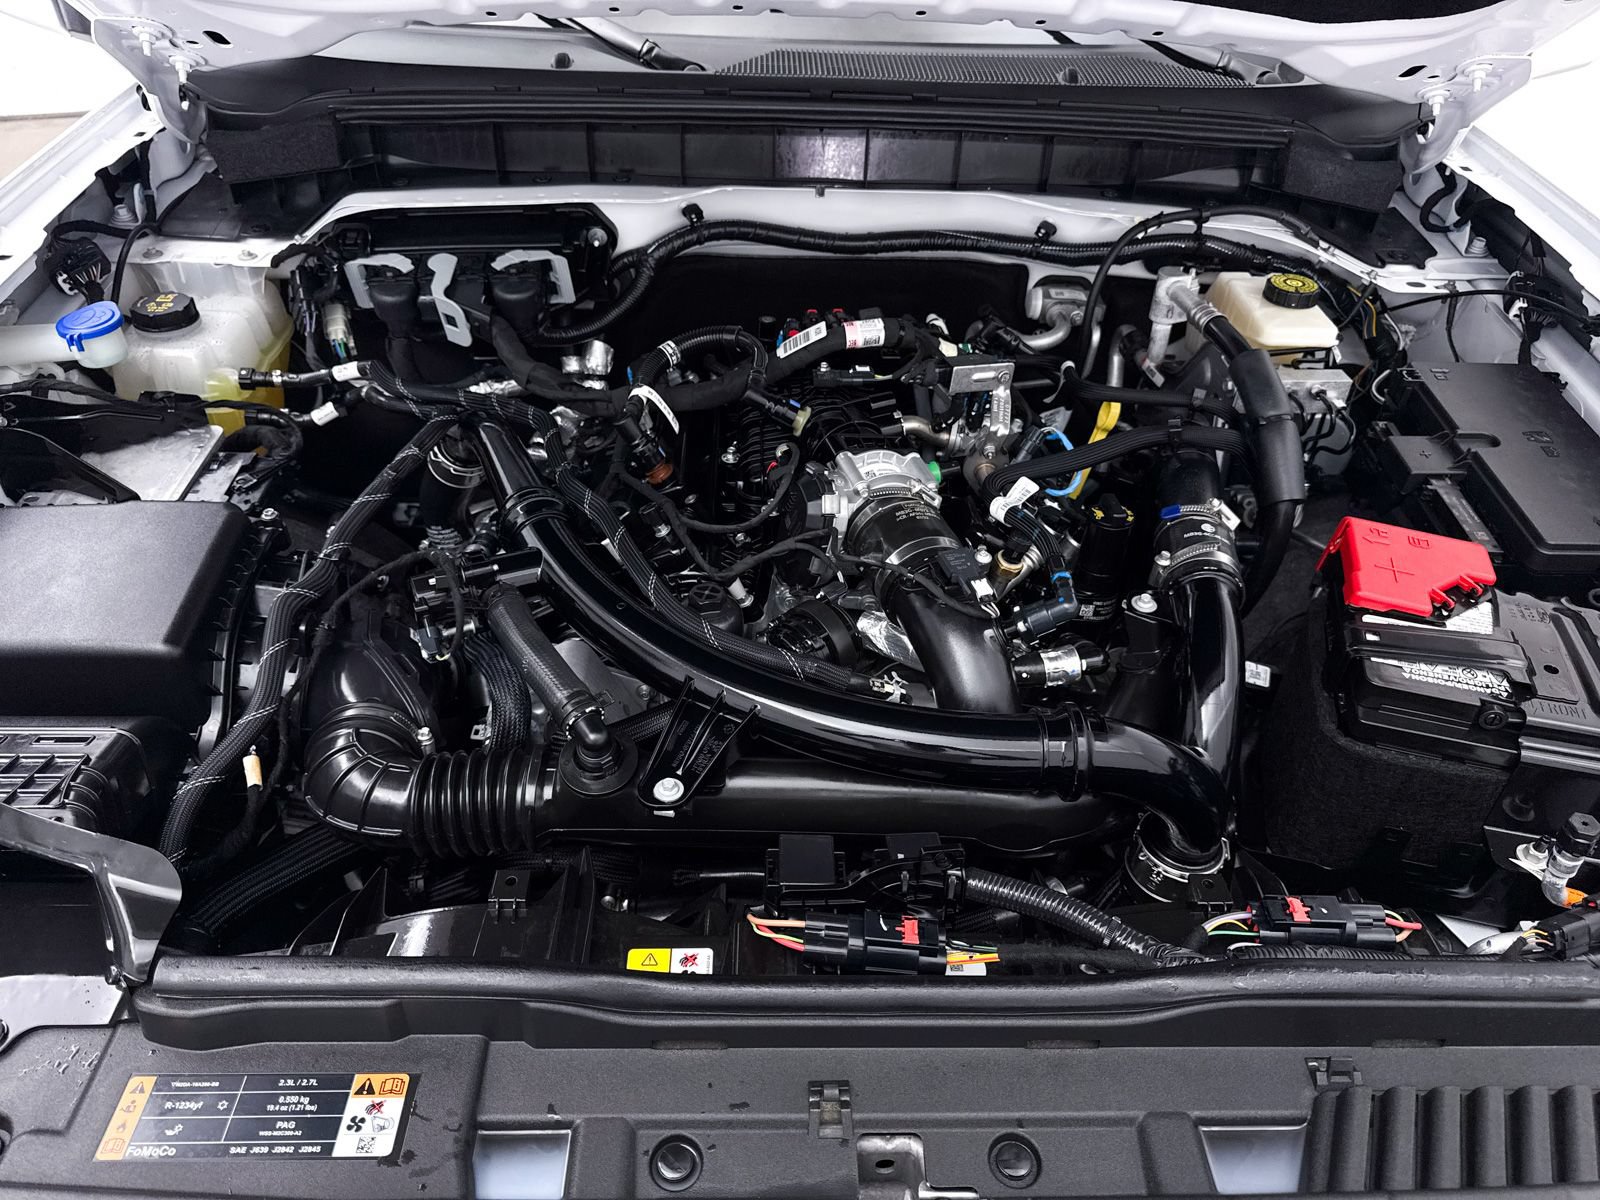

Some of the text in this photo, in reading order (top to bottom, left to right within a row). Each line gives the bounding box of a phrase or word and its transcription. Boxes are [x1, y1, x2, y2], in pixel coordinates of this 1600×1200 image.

[301, 1078, 318, 1086] 2.7L
[299, 1095, 310, 1105] kg
[164, 1101, 204, 1111] R-1234yf
[275, 1121, 296, 1129] PAG
[125, 1145, 177, 1157] FoMoCo
[229, 1146, 247, 1154] SAE
